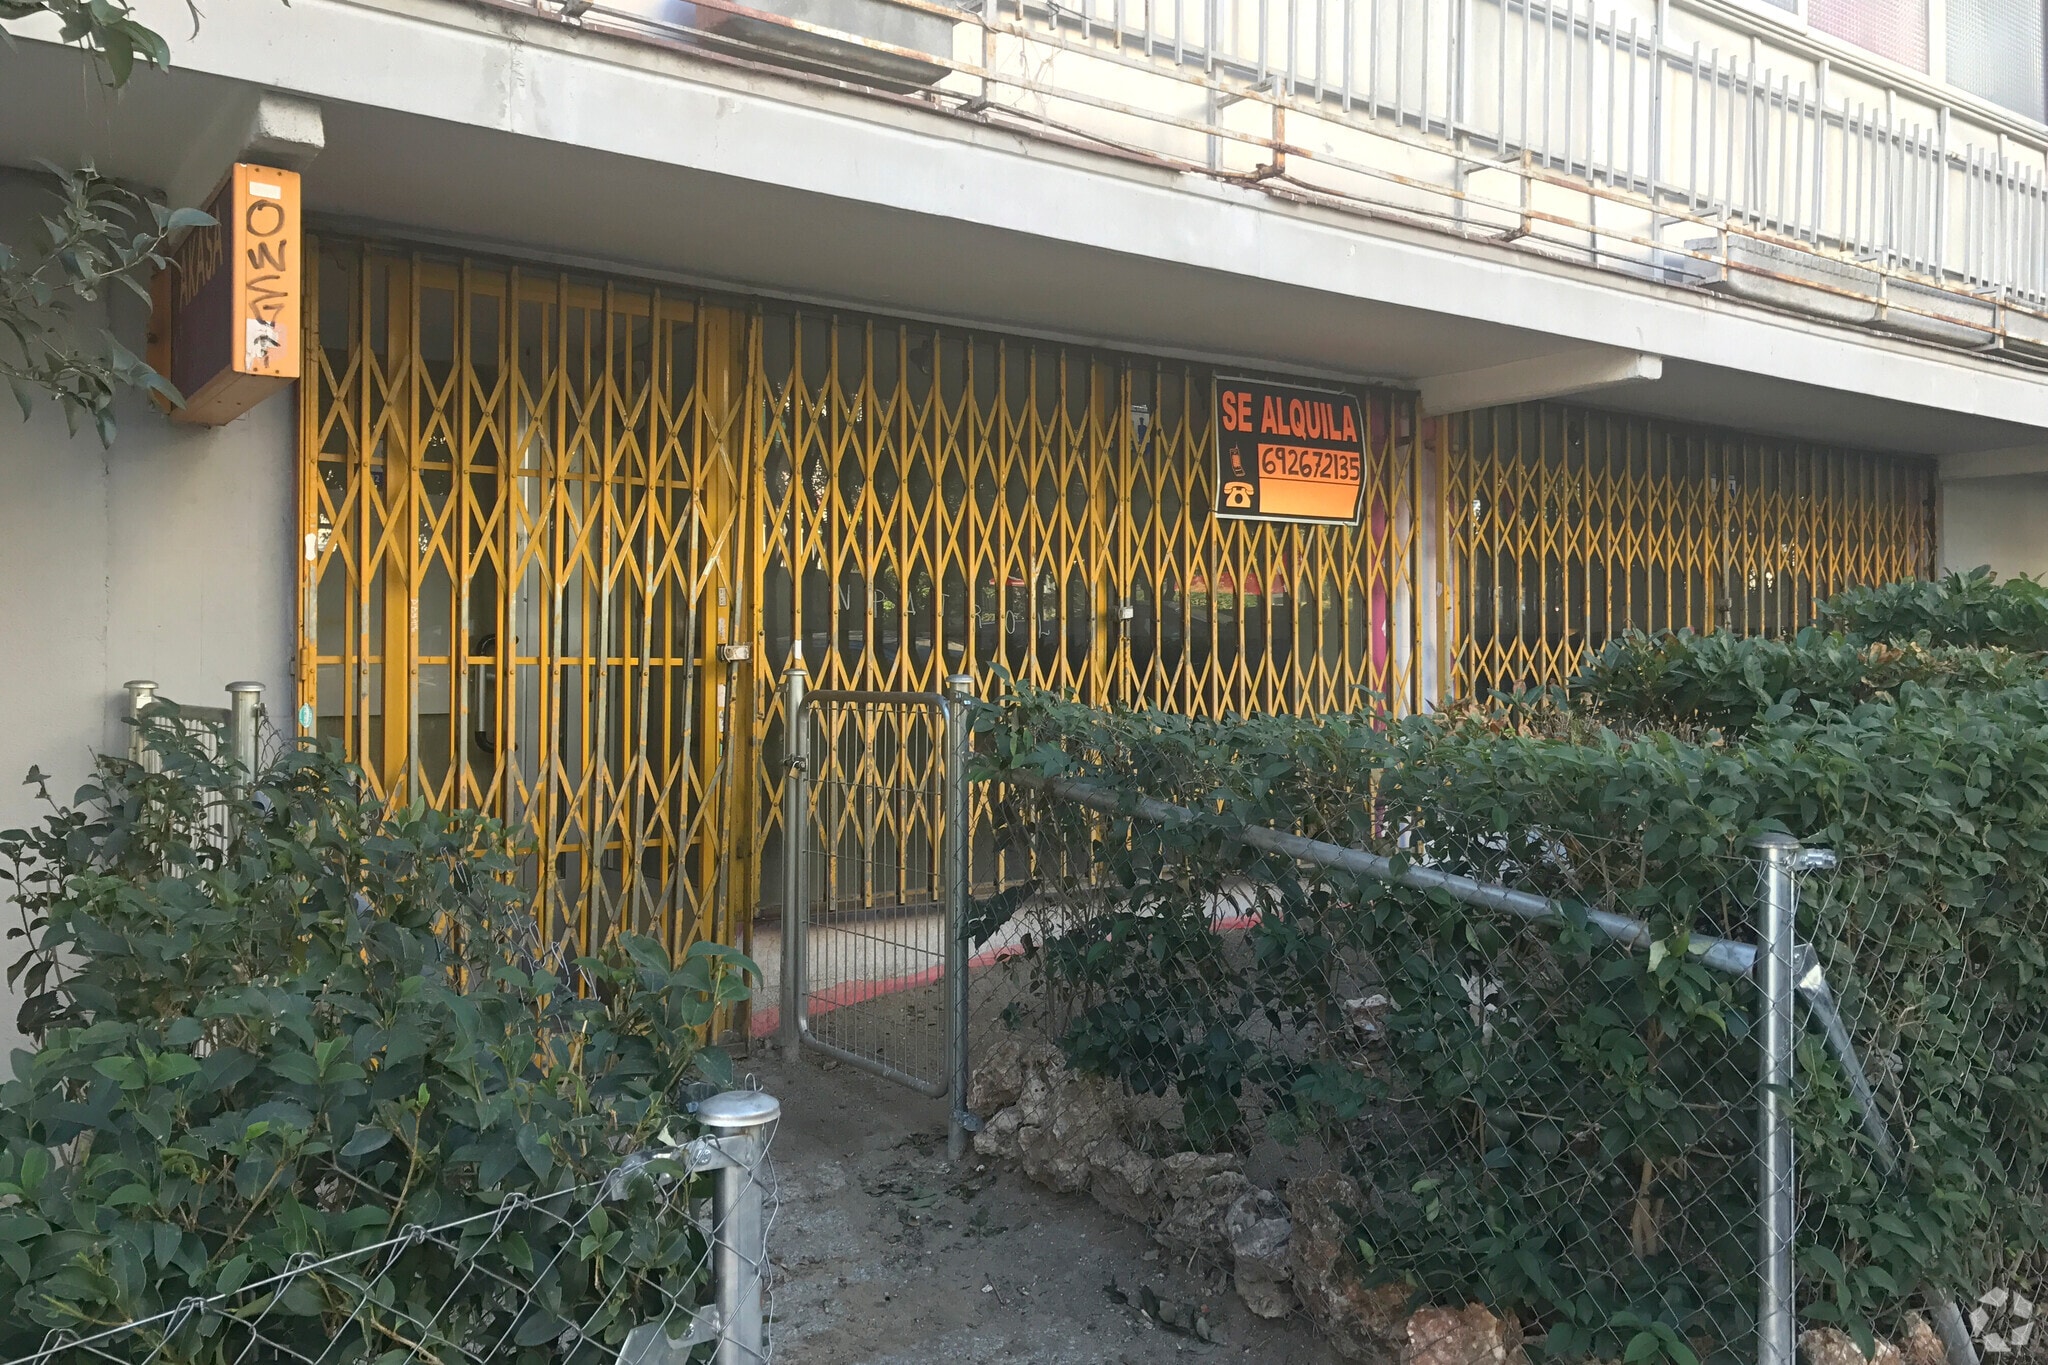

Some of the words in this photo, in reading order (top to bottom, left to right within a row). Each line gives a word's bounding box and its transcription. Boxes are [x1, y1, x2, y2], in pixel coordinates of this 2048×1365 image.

[1222, 391, 1253, 432] SE
[1261, 395, 1357, 442] ALQUILA
[1262, 447, 1360, 481] 692672135
